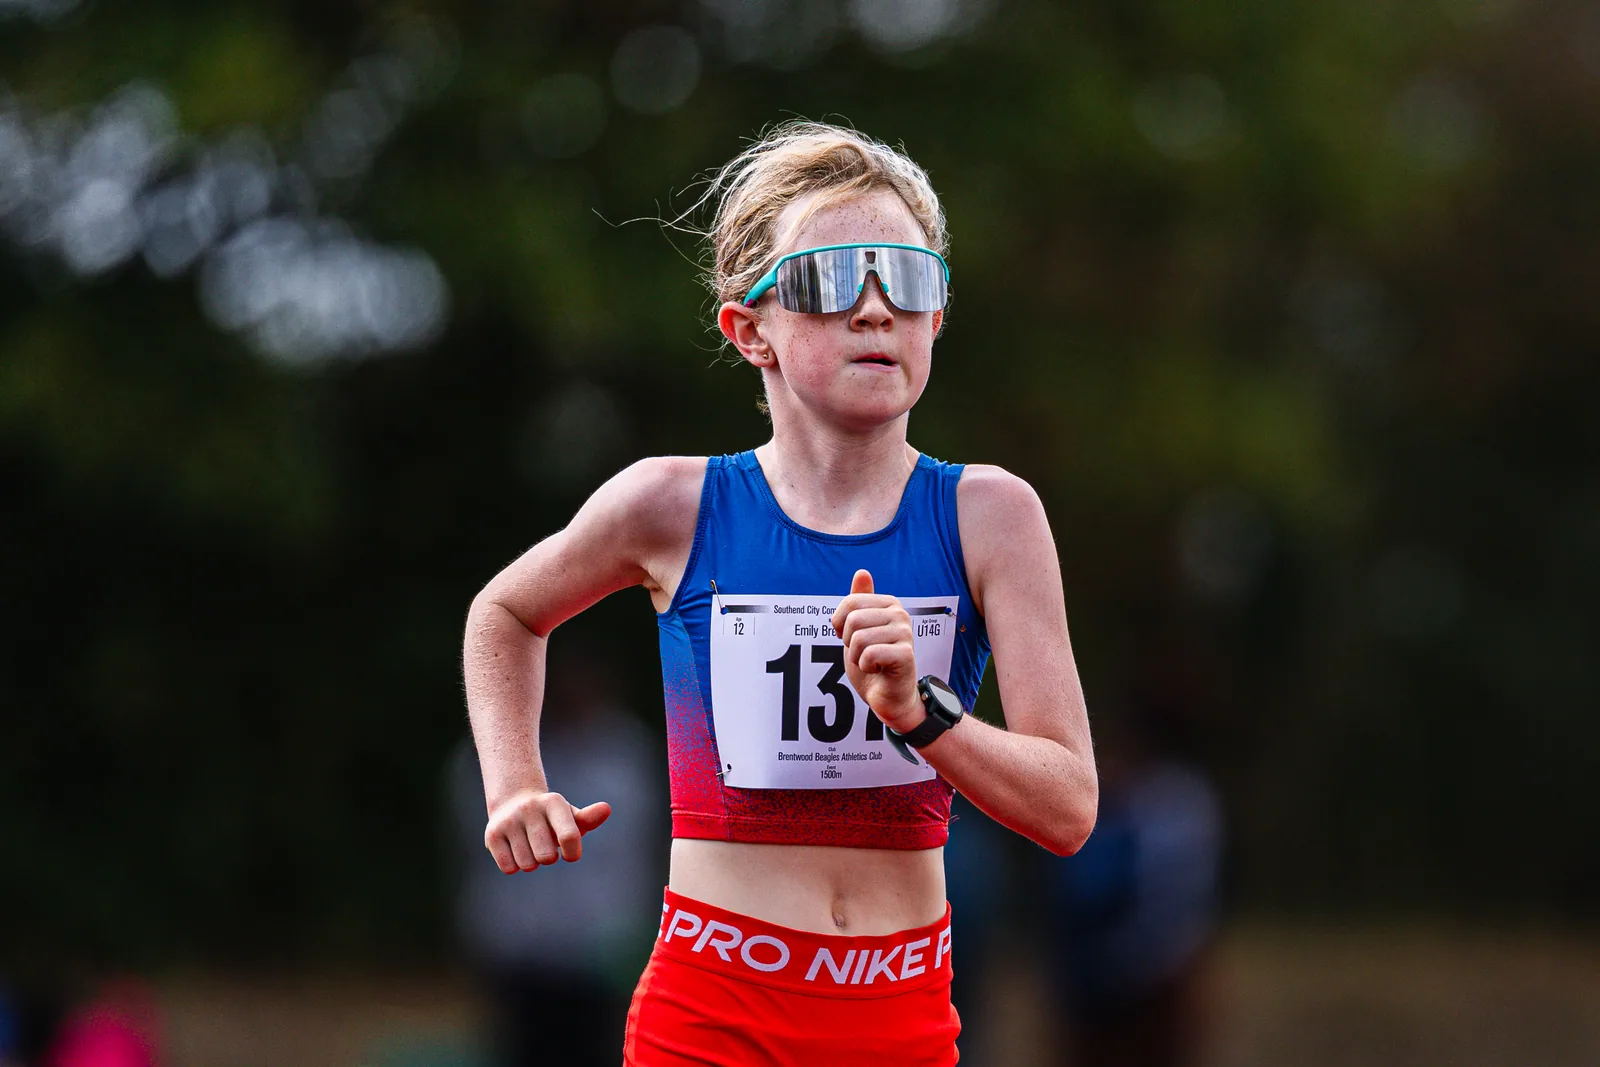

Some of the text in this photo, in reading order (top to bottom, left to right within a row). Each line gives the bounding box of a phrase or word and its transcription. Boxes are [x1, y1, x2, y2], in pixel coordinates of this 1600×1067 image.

[773, 605, 837, 616] Southend City Com
[734, 622, 744, 635] 12
[794, 624, 837, 638] Emily Bre
[917, 623, 941, 637] U14G
[778, 751, 883, 763] Brentwood Beagles Athletics Club
[820, 770, 842, 779] 1500m
[664, 909, 790, 972] PRO
[804, 937, 930, 985] NIKE
